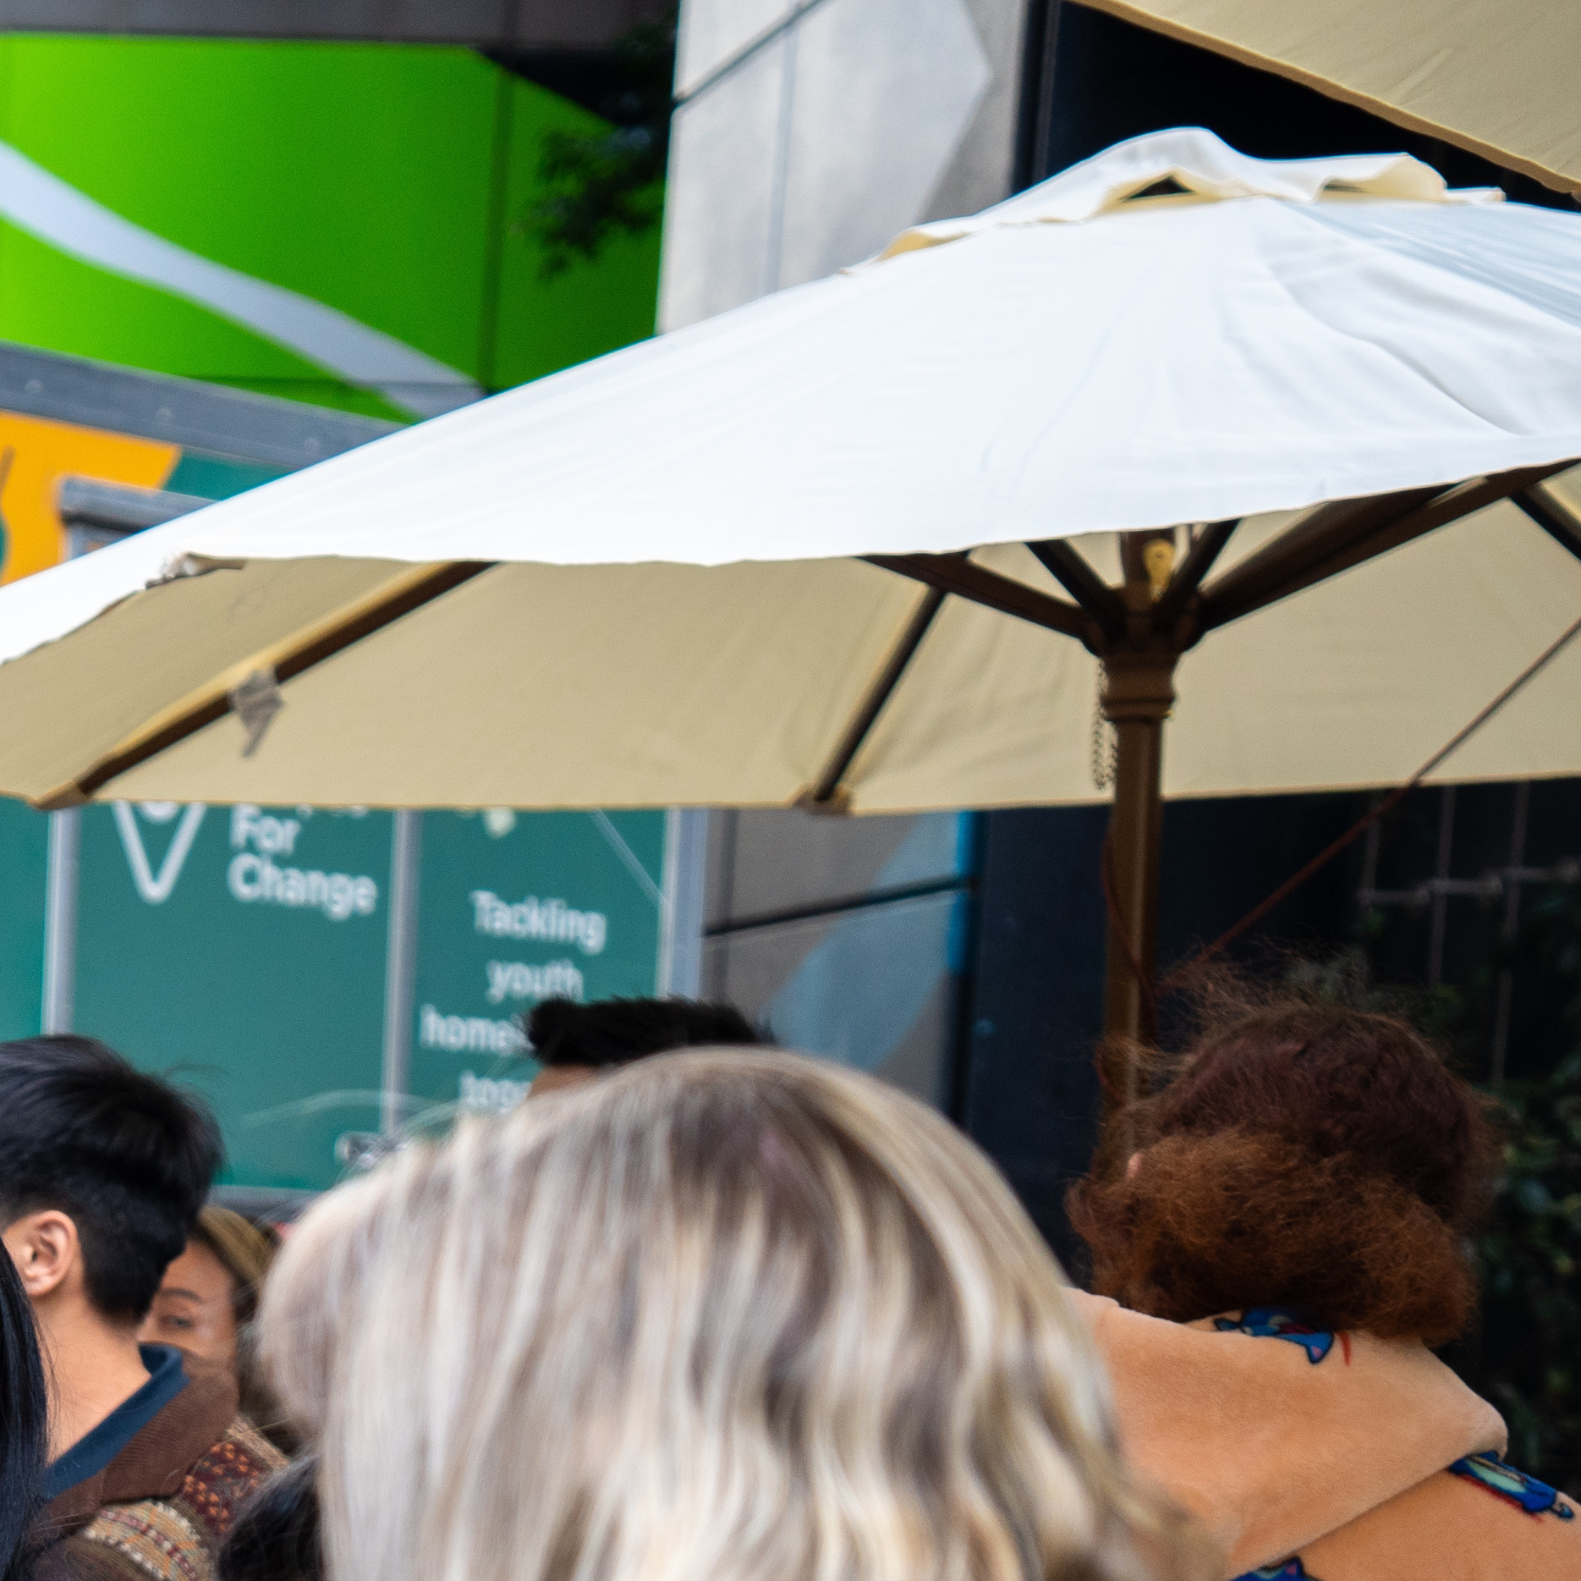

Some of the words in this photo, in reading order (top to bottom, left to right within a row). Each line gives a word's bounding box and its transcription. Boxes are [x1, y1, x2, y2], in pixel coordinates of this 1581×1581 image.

[229, 803, 301, 856] For
[226, 852, 379, 922] Change
[468, 889, 607, 956] Tackling
[487, 959, 584, 1004] youth
